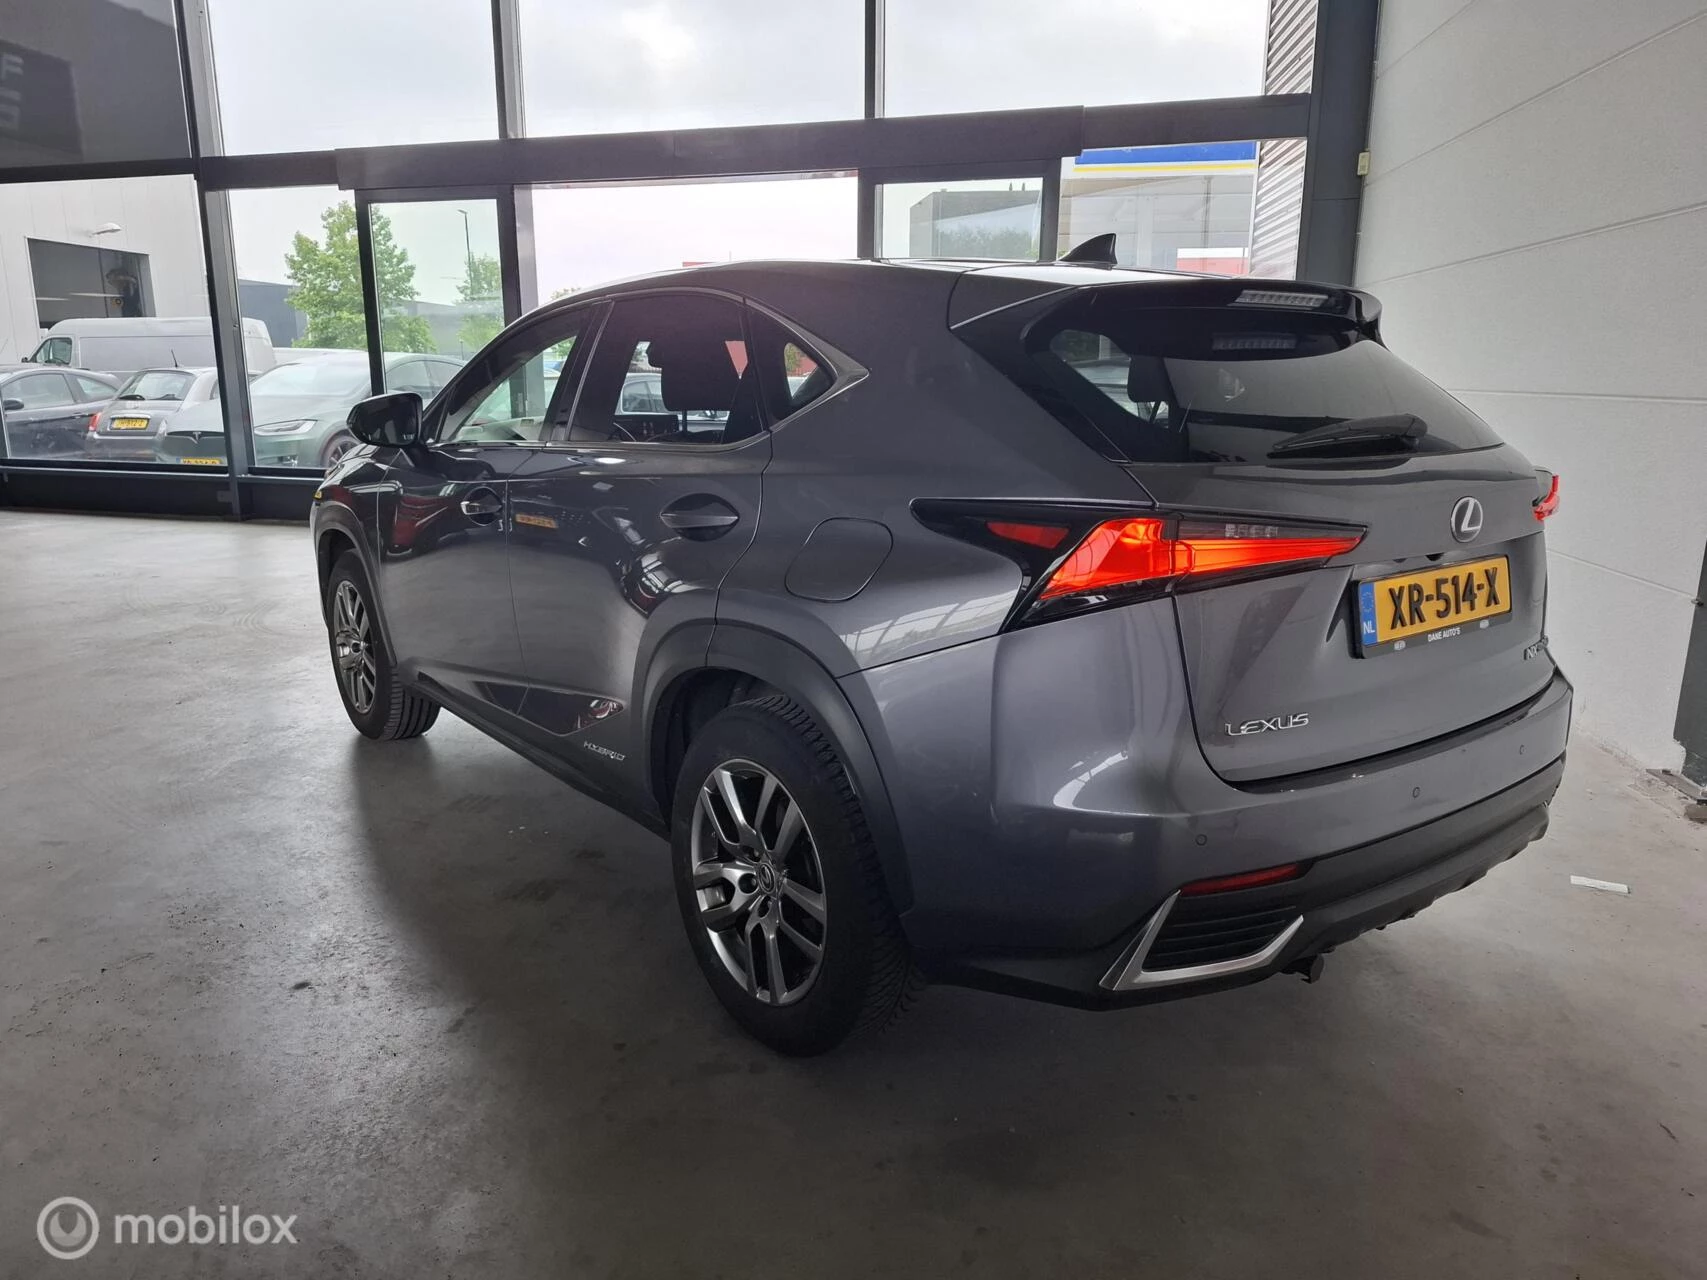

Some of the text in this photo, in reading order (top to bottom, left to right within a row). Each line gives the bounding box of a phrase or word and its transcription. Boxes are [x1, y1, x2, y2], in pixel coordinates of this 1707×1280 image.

[1388, 567, 1500, 630] XR-514-X
[1362, 621, 1375, 634] NL
[1224, 713, 1309, 736] LEXUS
